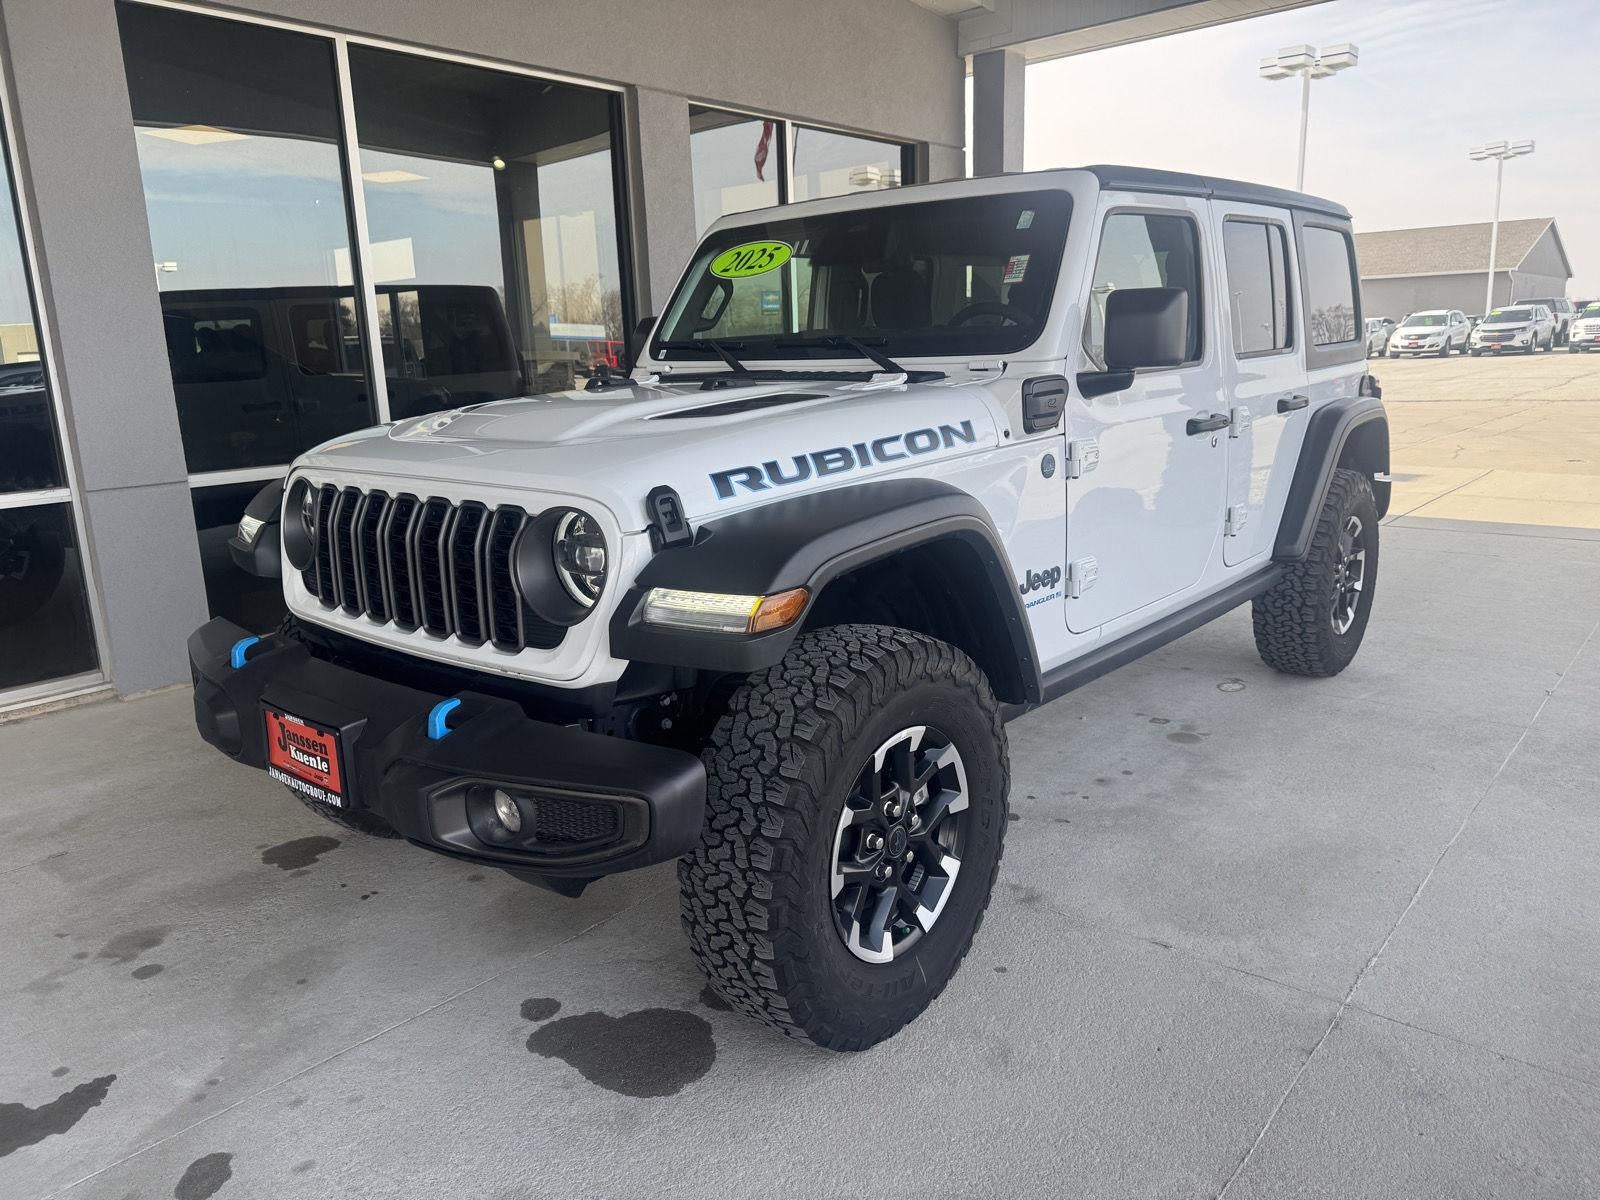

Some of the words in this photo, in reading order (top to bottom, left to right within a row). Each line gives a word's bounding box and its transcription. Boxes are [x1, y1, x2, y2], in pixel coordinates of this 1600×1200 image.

[720, 246, 782, 273] 2025
[708, 419, 977, 500] RUBICON
[1019, 565, 1061, 595] Jeep
[1025, 593, 1055, 609] RANGLER
[277, 721, 328, 756] Janssen
[289, 744, 329, 772] Kuenle
